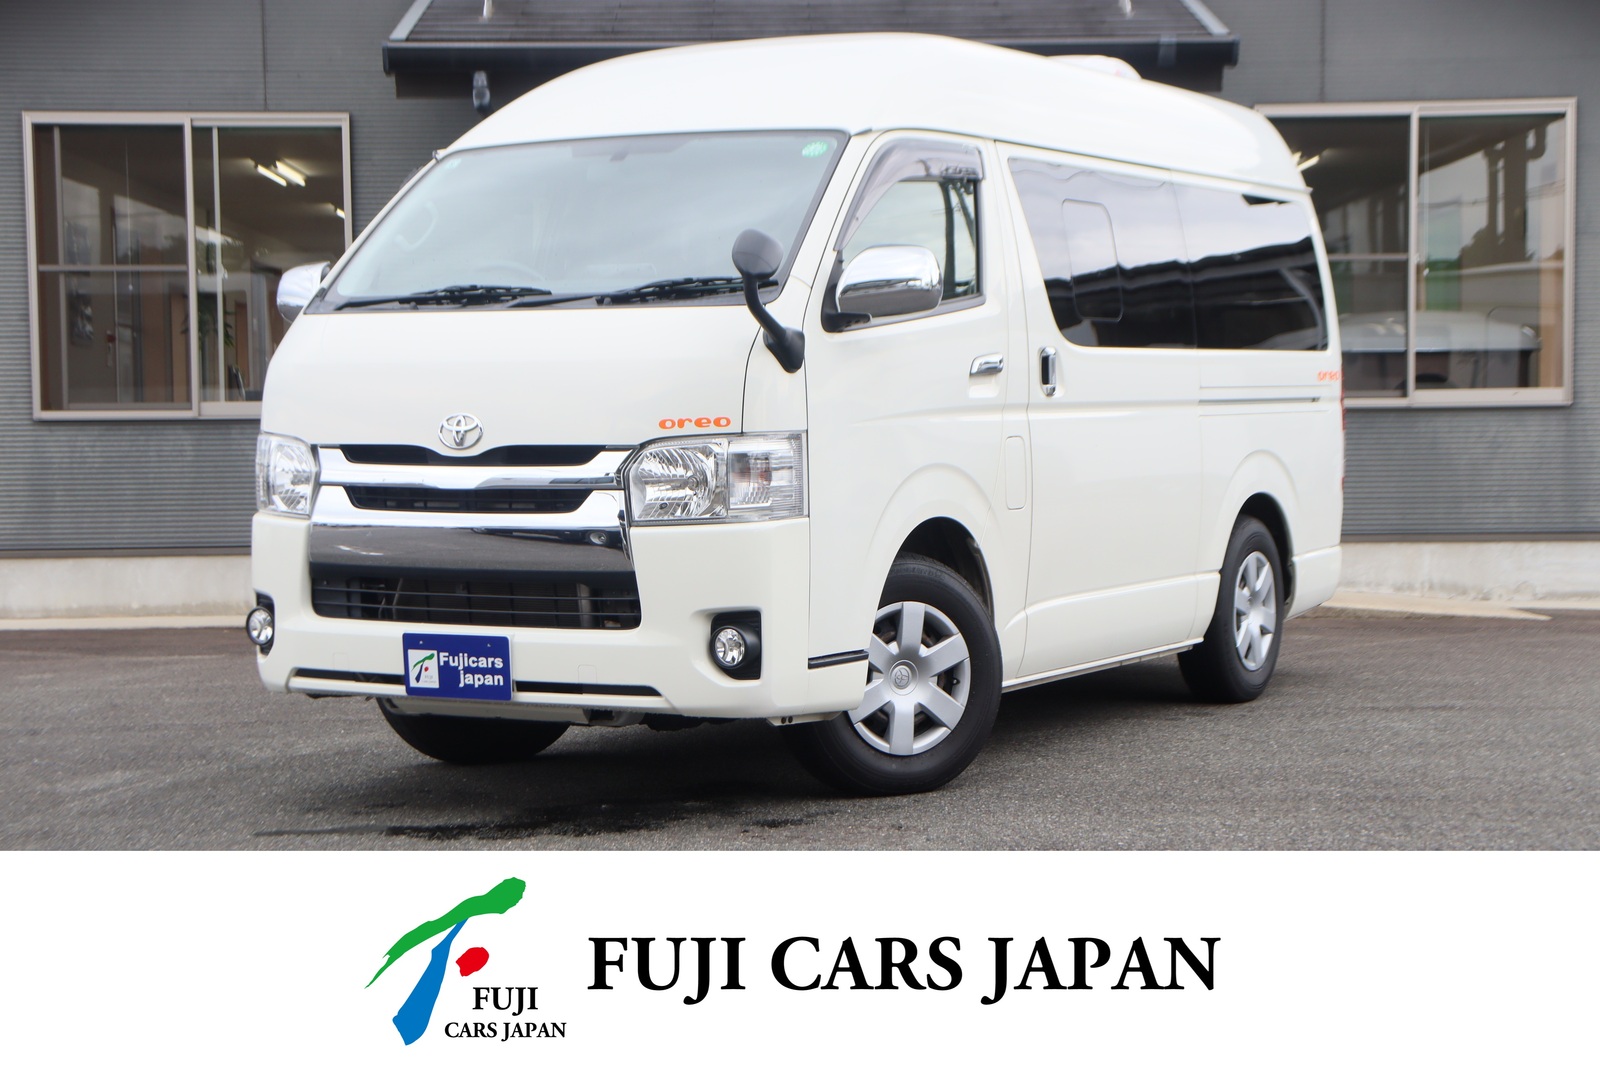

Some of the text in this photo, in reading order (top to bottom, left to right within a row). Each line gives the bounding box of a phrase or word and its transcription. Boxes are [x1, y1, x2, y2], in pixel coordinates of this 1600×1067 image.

[658, 416, 731, 430] oreo
[439, 652, 504, 670] Fujicars
[459, 670, 504, 688] japan
